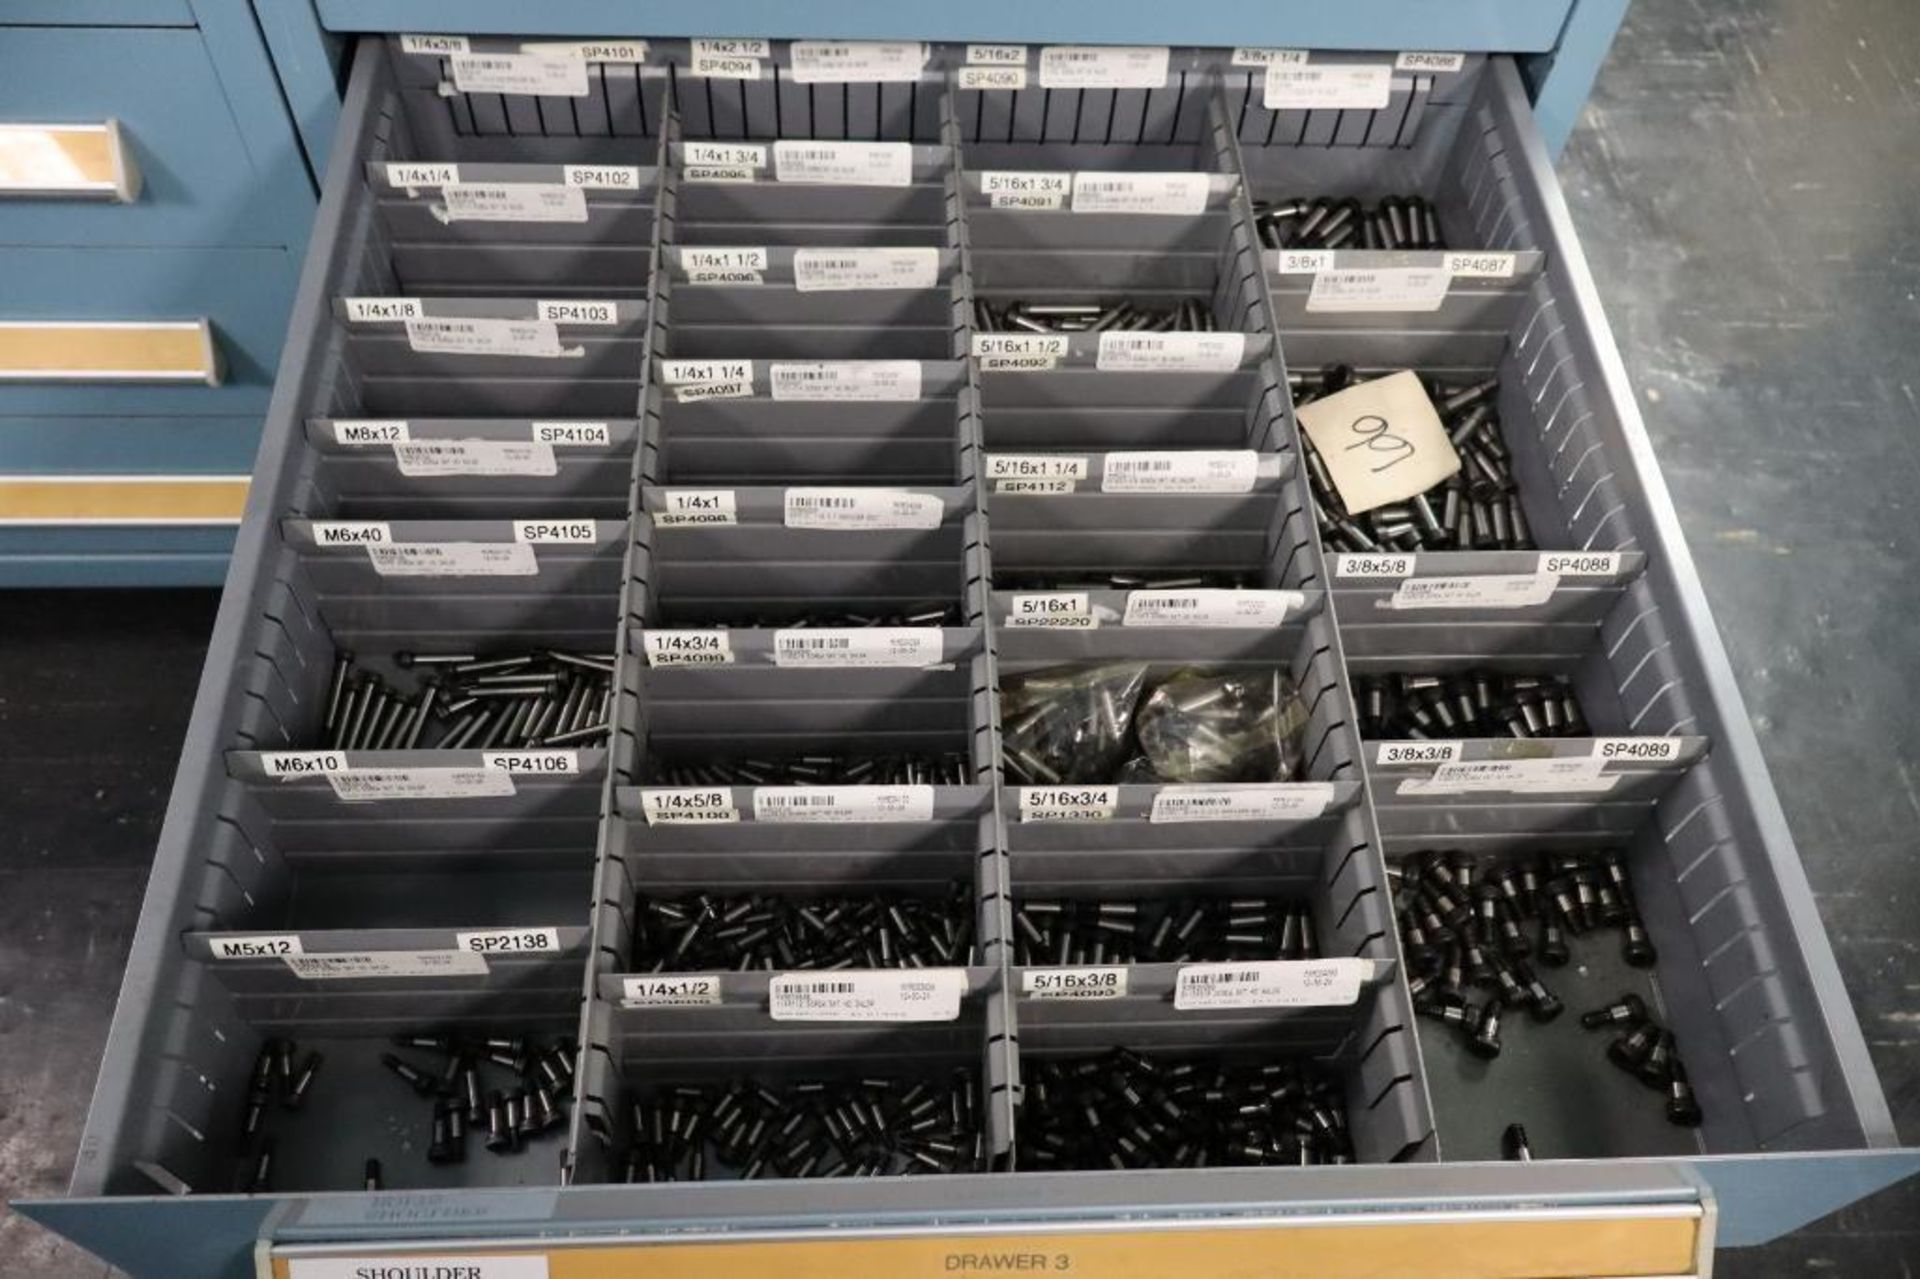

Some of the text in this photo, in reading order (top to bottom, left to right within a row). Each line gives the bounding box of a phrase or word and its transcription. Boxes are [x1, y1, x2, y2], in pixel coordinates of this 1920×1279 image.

[581, 47, 635, 58] SP4101
[701, 42, 762, 53] 1/4x2 1/2
[973, 49, 1019, 61] 5/16x2
[1279, 51, 1300, 63] 1/4
[700, 61, 752, 71] SP4094
[966, 73, 1018, 85] SP4090
[694, 149, 758, 163] 1/4x1 3/4
[398, 170, 451, 181] 1/4x1/4
[573, 171, 629, 184] SP4102
[989, 177, 1062, 190] 5/16x1 3/4
[692, 253, 760, 266] 1/4x1 1/2
[1451, 258, 1506, 272] SP4087
[358, 304, 414, 316] 1/4x1/8
[547, 307, 608, 320] SP4103
[981, 340, 1060, 353] 5/16x1 1/2
[673, 367, 744, 379] 1/4x1 1/4
[345, 427, 399, 440] M8x12
[541, 428, 604, 441] SP4104
[995, 462, 1078, 475] 5/16x1 1/4
[1005, 481, 1066, 491] SP4112
[677, 496, 719, 509] 1/4x1
[324, 528, 382, 542] M6x40
[524, 525, 591, 539] SP4105
[1346, 560, 1406, 573] 3/8x5/8
[1547, 558, 1610, 571] SP4088
[1022, 599, 1077, 613] 5/16x1
[656, 636, 719, 650] 1/4x3/4
[1387, 747, 1451, 761] 3/8x3/8
[1603, 743, 1670, 757] SP4089
[275, 757, 338, 771] M6x10
[494, 757, 567, 771] SP4106
[653, 794, 723, 808] 1/4x5/8
[1030, 792, 1108, 806] 5/16x3/4
[470, 934, 548, 950] SP2138
[223, 942, 290, 956] M5x12
[1034, 973, 1117, 988] 5/16x3/8
[638, 982, 709, 996] 1/4x1/2
[945, 1254, 1070, 1271] DRAWER 3
[356, 1267, 481, 1279] SHOULDER
